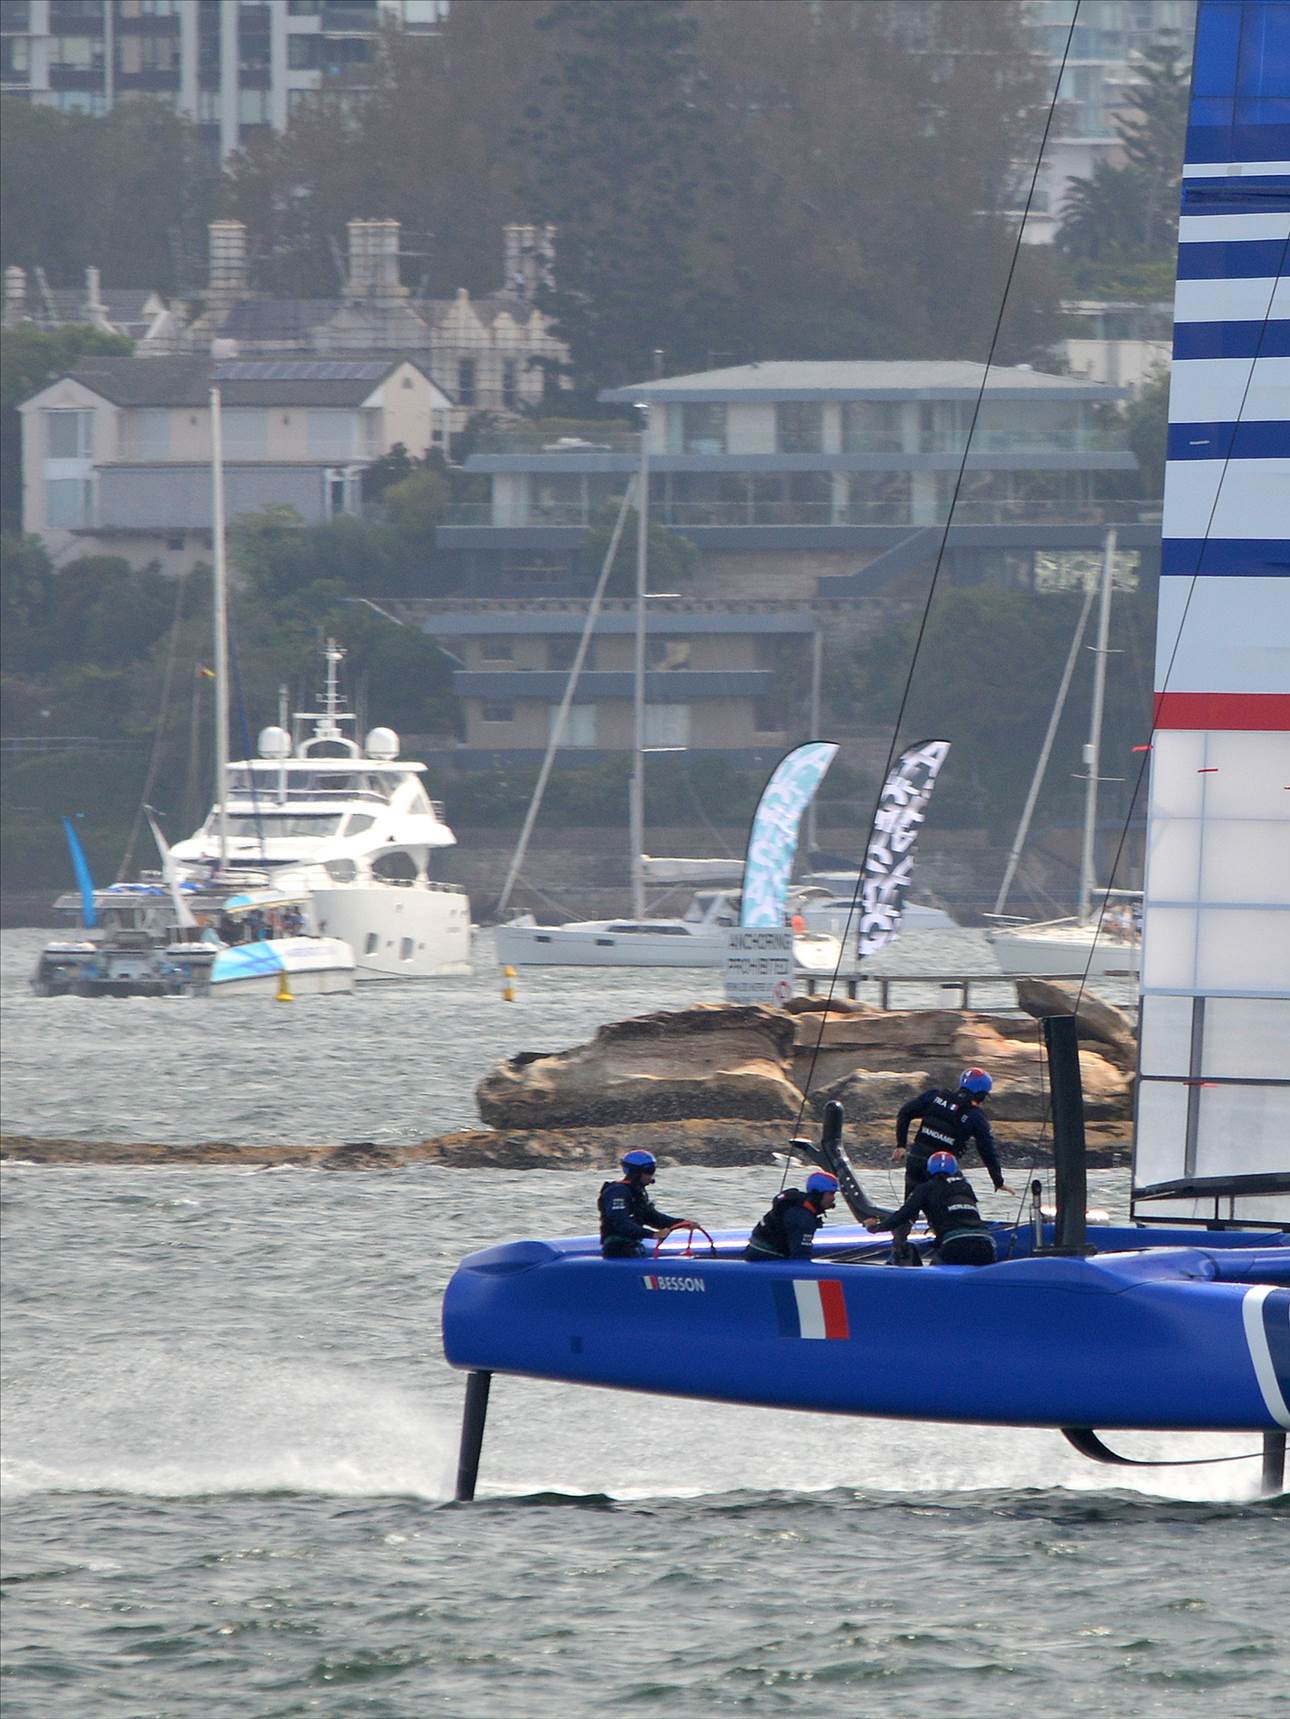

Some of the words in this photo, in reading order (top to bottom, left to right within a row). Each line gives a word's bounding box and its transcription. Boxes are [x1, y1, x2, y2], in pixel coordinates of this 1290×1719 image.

[728, 958, 788, 976] PROHIBITED
[933, 1096, 947, 1108] FRA
[657, 1276, 705, 1292] BESSON
